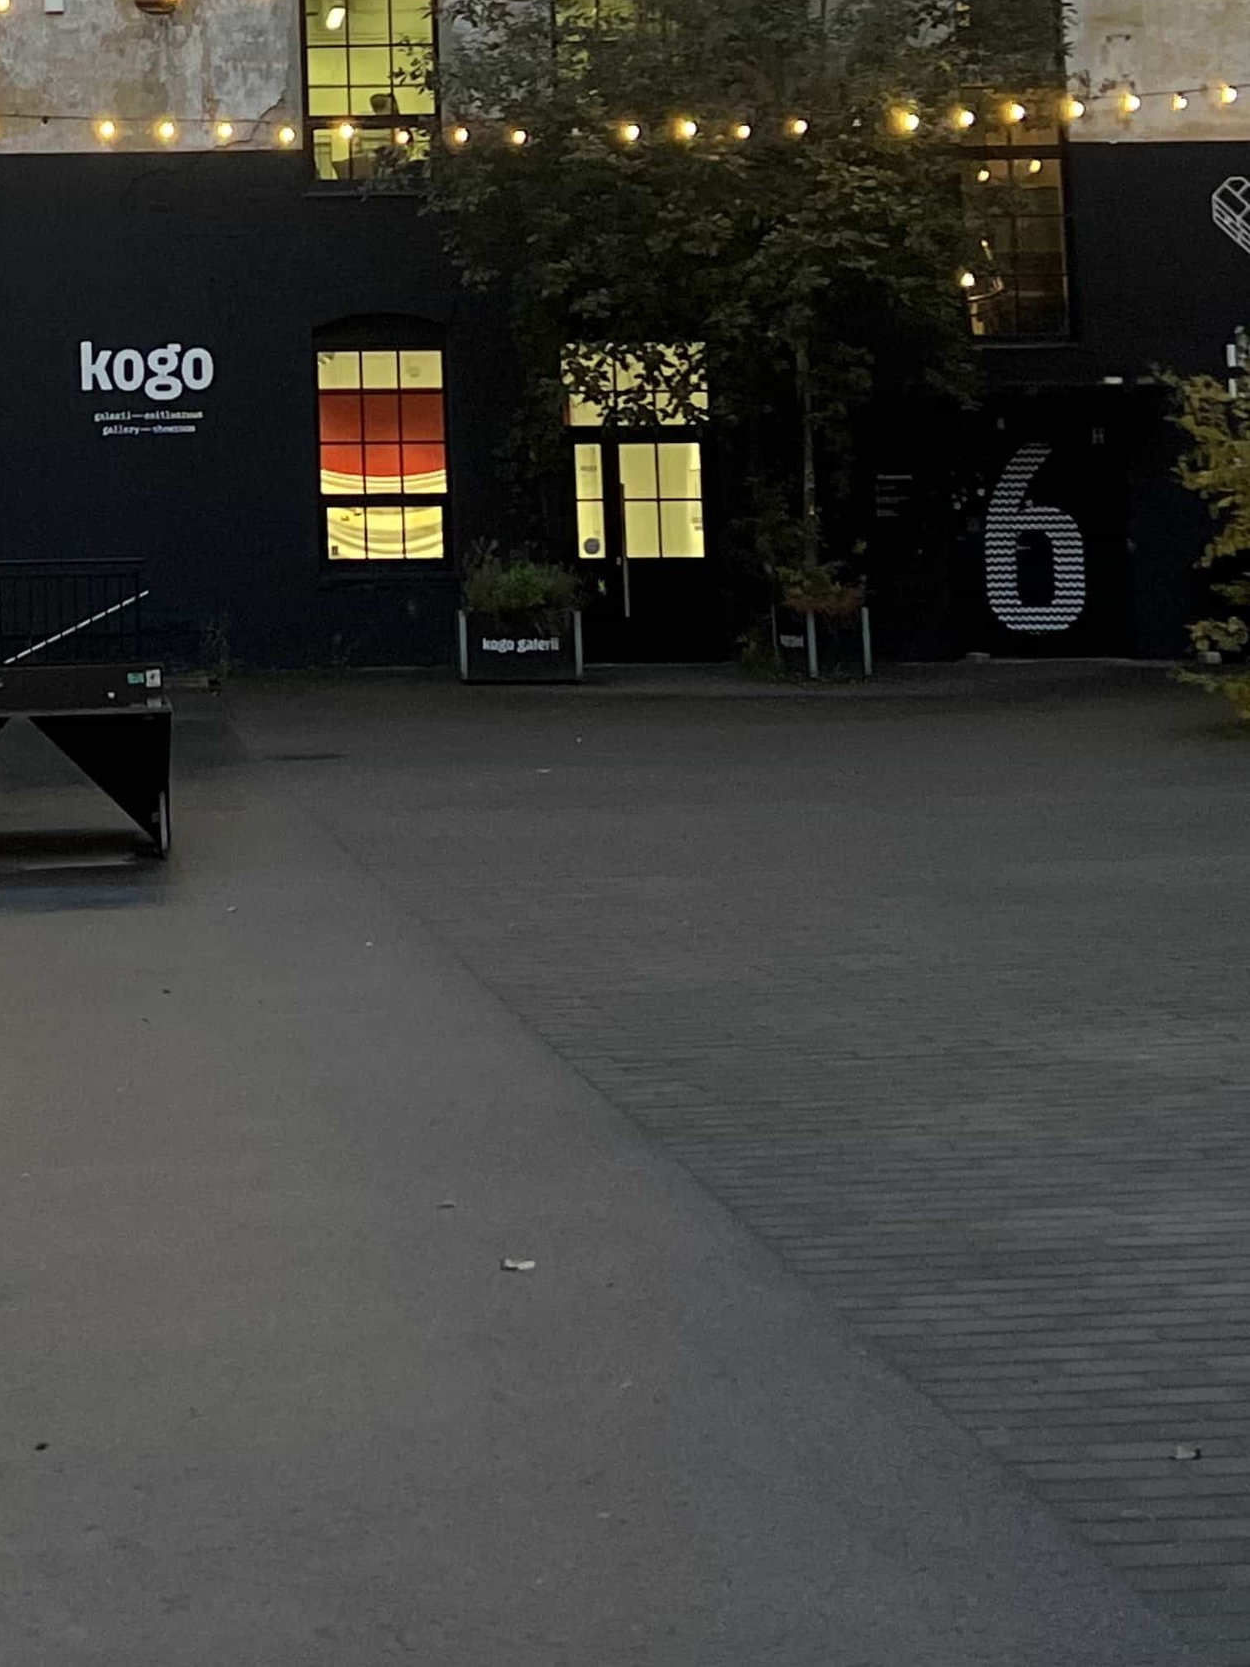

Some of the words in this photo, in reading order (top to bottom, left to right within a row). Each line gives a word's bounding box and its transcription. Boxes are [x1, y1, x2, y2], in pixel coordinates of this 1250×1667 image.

[80, 341, 214, 401] kogo
[984, 443, 1086, 633] 6
[482, 637, 515, 653] kogo
[516, 637, 560, 653] galerii
